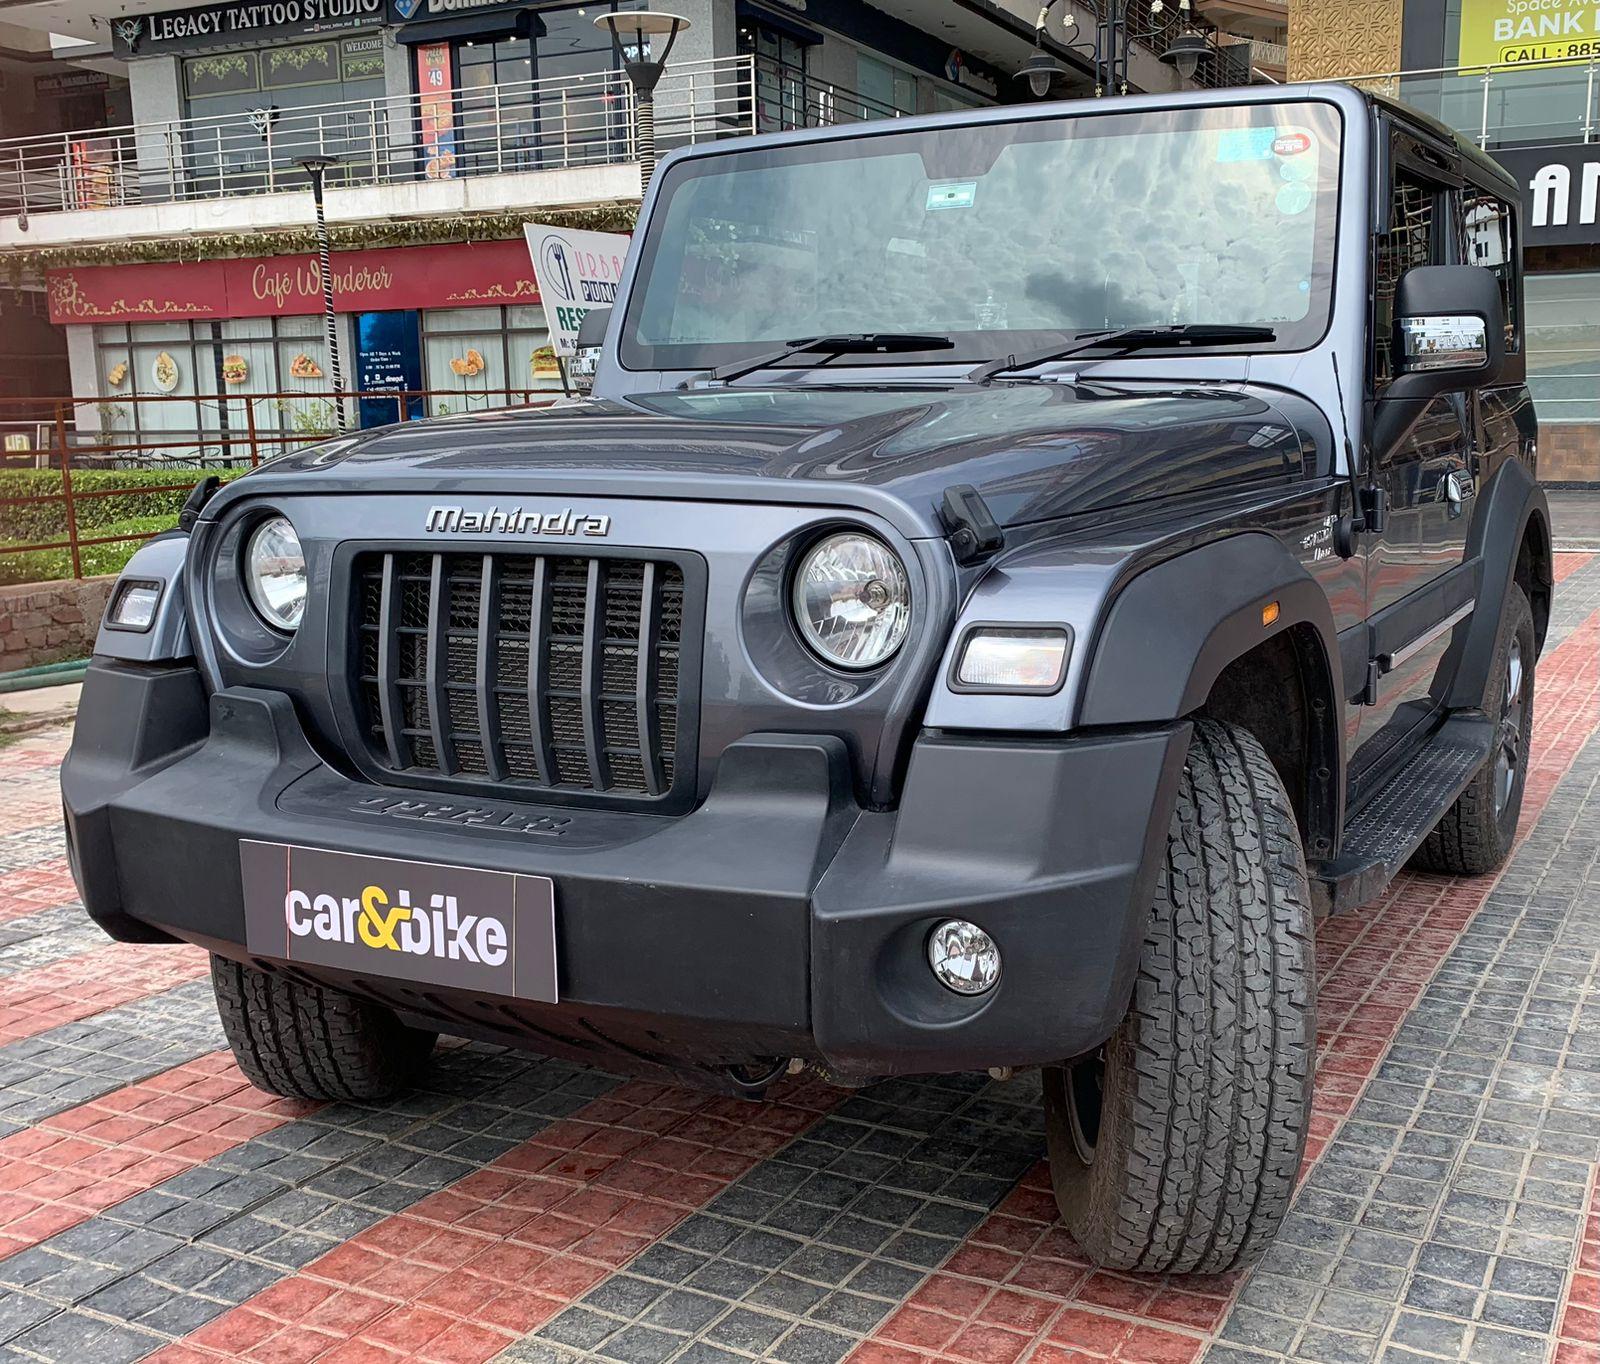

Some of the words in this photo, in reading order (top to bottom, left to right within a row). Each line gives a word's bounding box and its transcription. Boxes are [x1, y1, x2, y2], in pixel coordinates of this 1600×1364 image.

[150, 11, 222, 41] LEGACY
[227, 1, 300, 30] TATTOO
[304, 0, 379, 19] STUDIO
[1507, 0, 1562, 15] Space
[1494, 10, 1584, 41] BANK
[346, 40, 383, 52] WELCOME
[623, 44, 651, 58] OPN
[1505, 47, 1552, 62] CALL
[574, 251, 627, 279] URBA
[253, 264, 293, 308] Café
[297, 260, 393, 294] Wnderer
[556, 307, 591, 331] RES
[425, 505, 611, 536] Mahindra
[285, 885, 508, 967] car&bike
